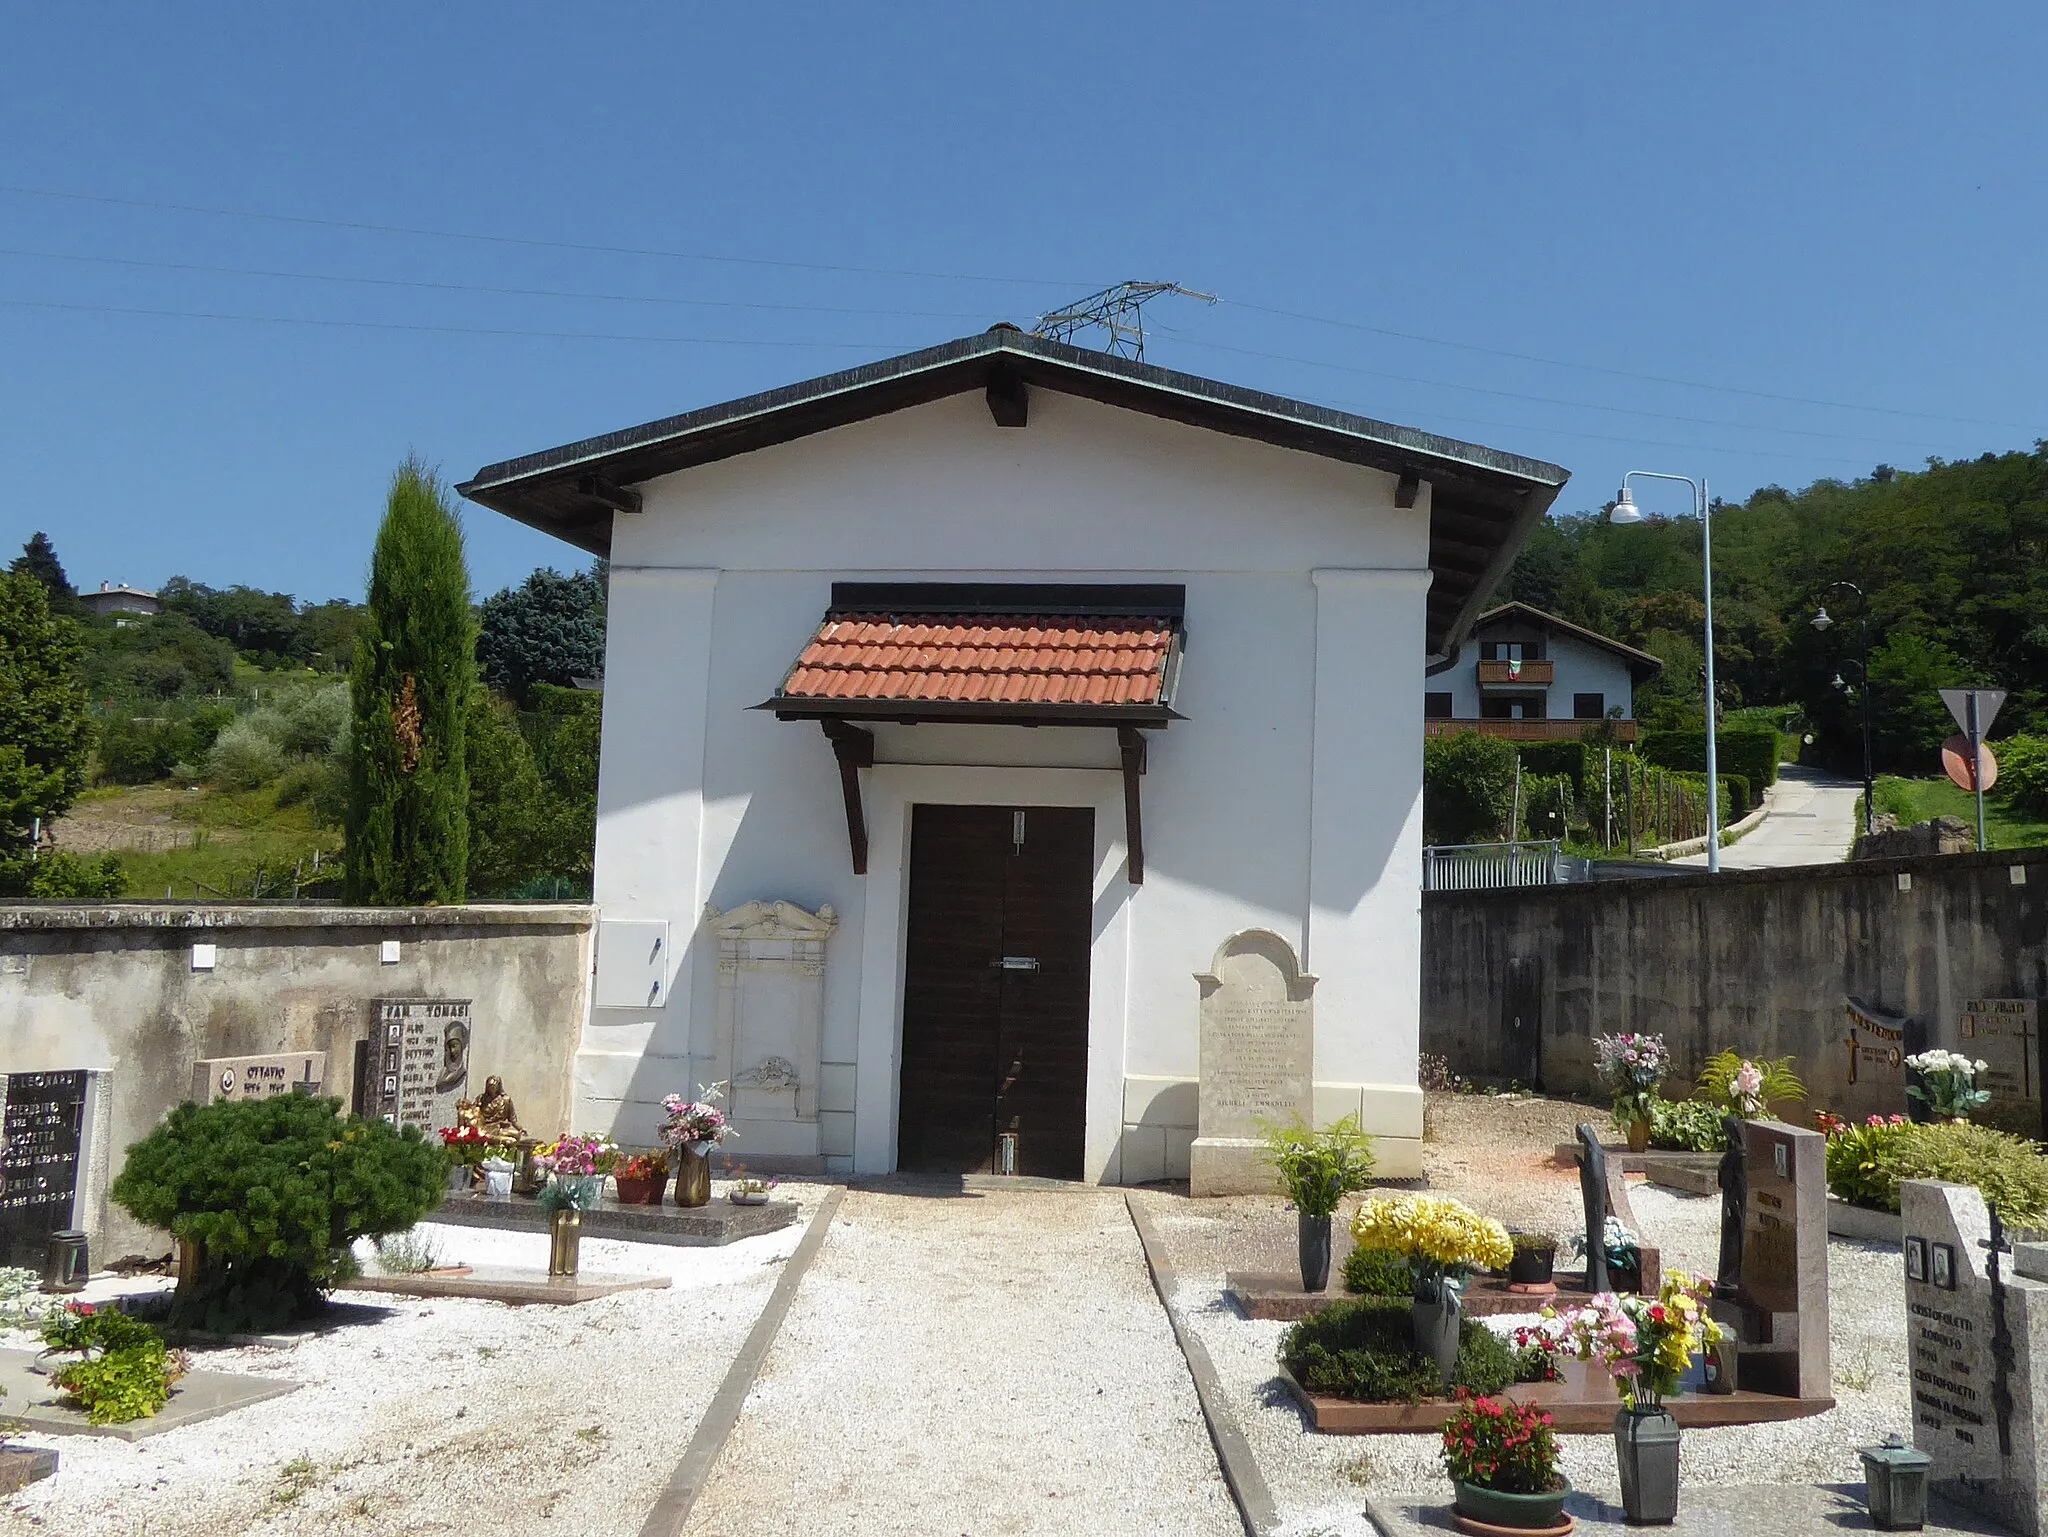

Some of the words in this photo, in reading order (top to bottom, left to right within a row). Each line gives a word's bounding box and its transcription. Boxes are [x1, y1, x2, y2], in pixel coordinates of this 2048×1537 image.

[426, 1005, 468, 1017] TOMASI
[247, 1066, 285, 1080] OTTAVIO
[11, 1131, 56, 1146] ROSETTA
[1911, 1302, 1972, 1332] CRISTOFOLETTI
[1922, 1327, 1962, 1350] RODOLFO
[1915, 1368, 1976, 1401] CRISTOFOLETTI
